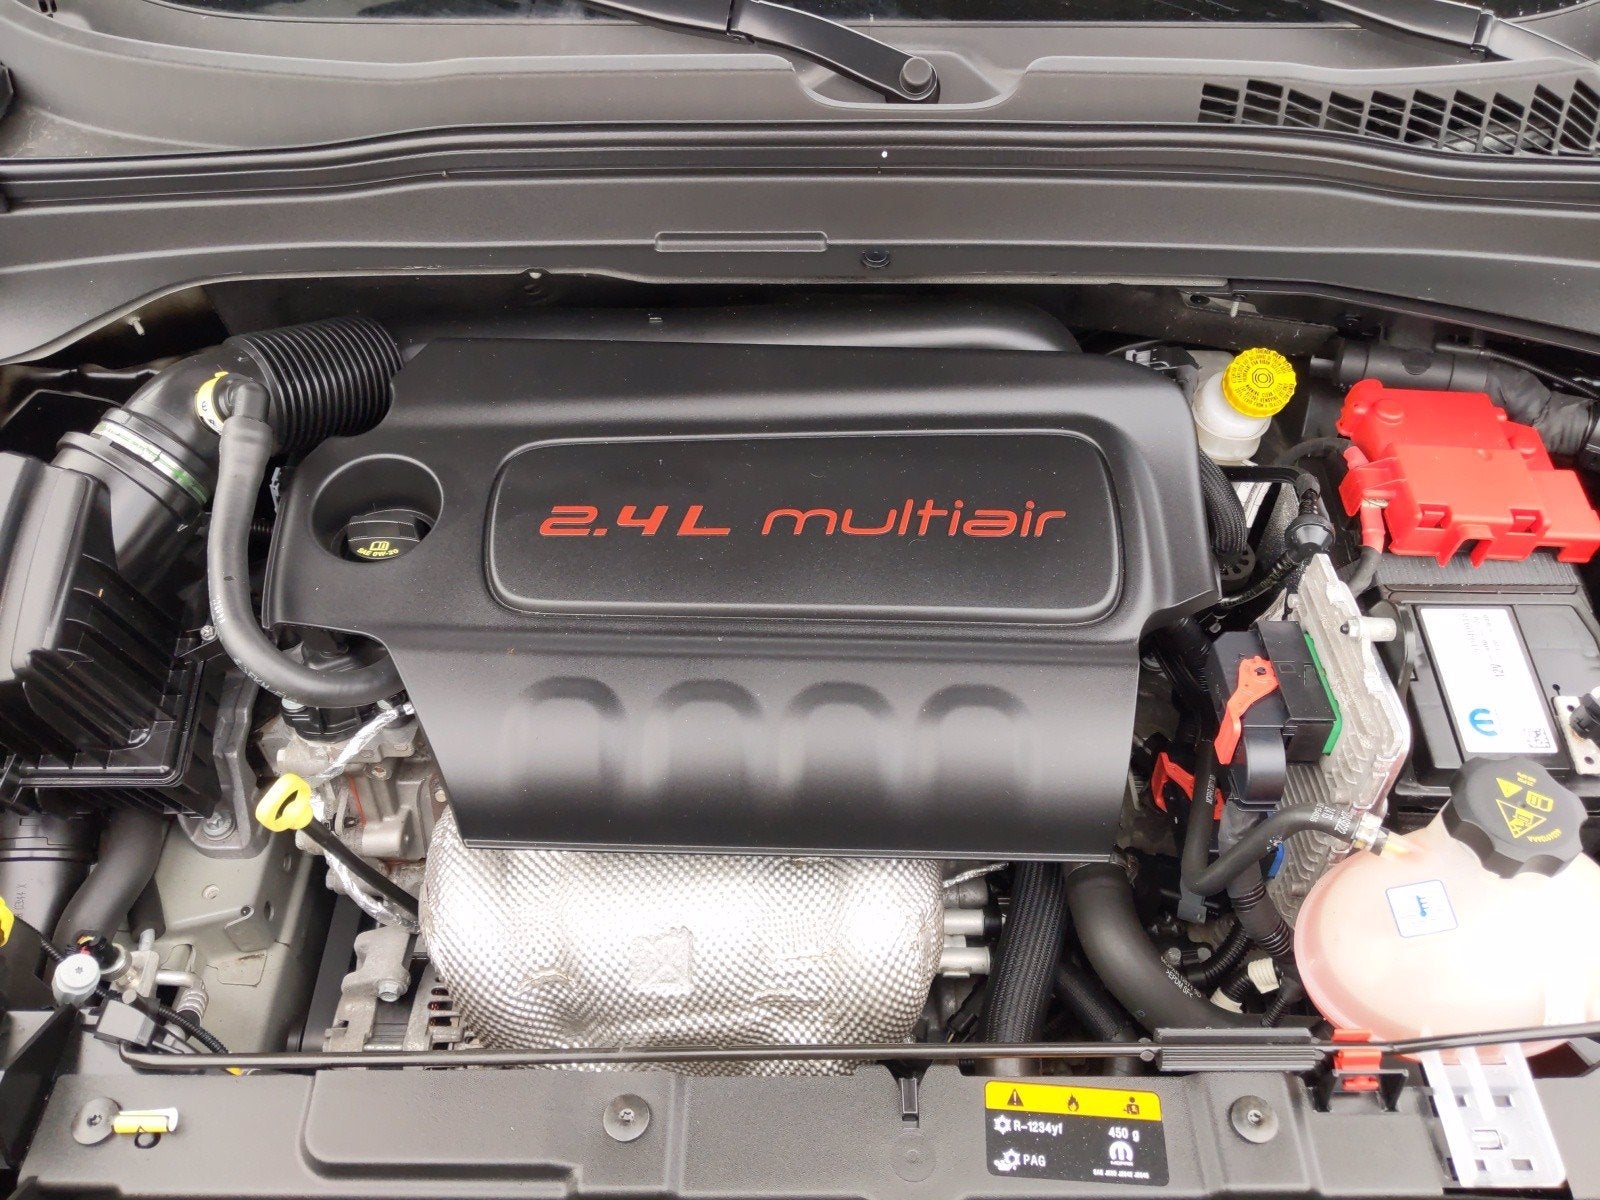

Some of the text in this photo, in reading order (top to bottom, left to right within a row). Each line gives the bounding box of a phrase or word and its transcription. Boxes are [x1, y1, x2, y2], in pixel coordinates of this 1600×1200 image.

[761, 498, 1066, 537] multiair
[1108, 1126, 1140, 1142] 450 g
[1023, 1153, 1047, 1167] PAG
